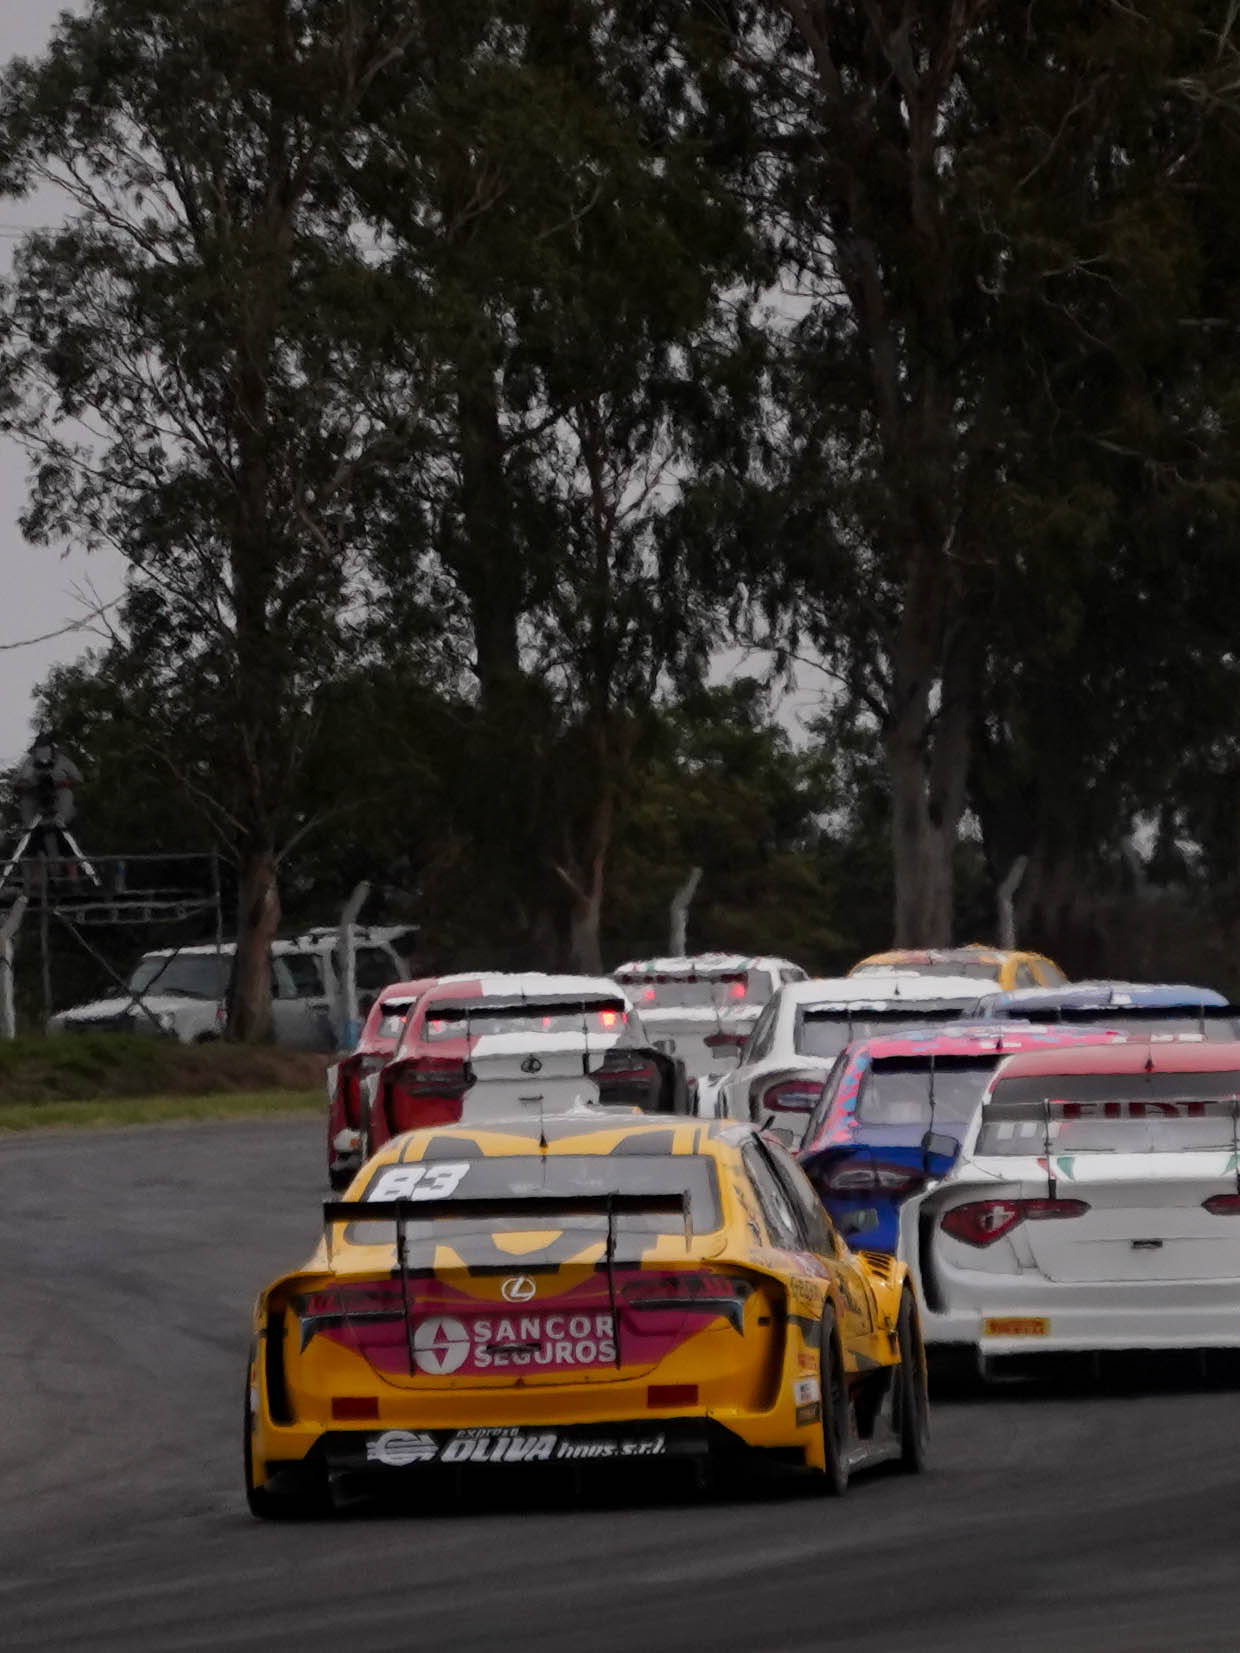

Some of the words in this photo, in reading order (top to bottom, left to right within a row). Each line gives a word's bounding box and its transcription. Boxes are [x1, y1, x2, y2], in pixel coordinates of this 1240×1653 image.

[367, 1163, 470, 1202] 83
[473, 1315, 614, 1342] SANCOR
[473, 1340, 617, 1368] SEGUROS
[440, 1434, 557, 1463] OLIVA
